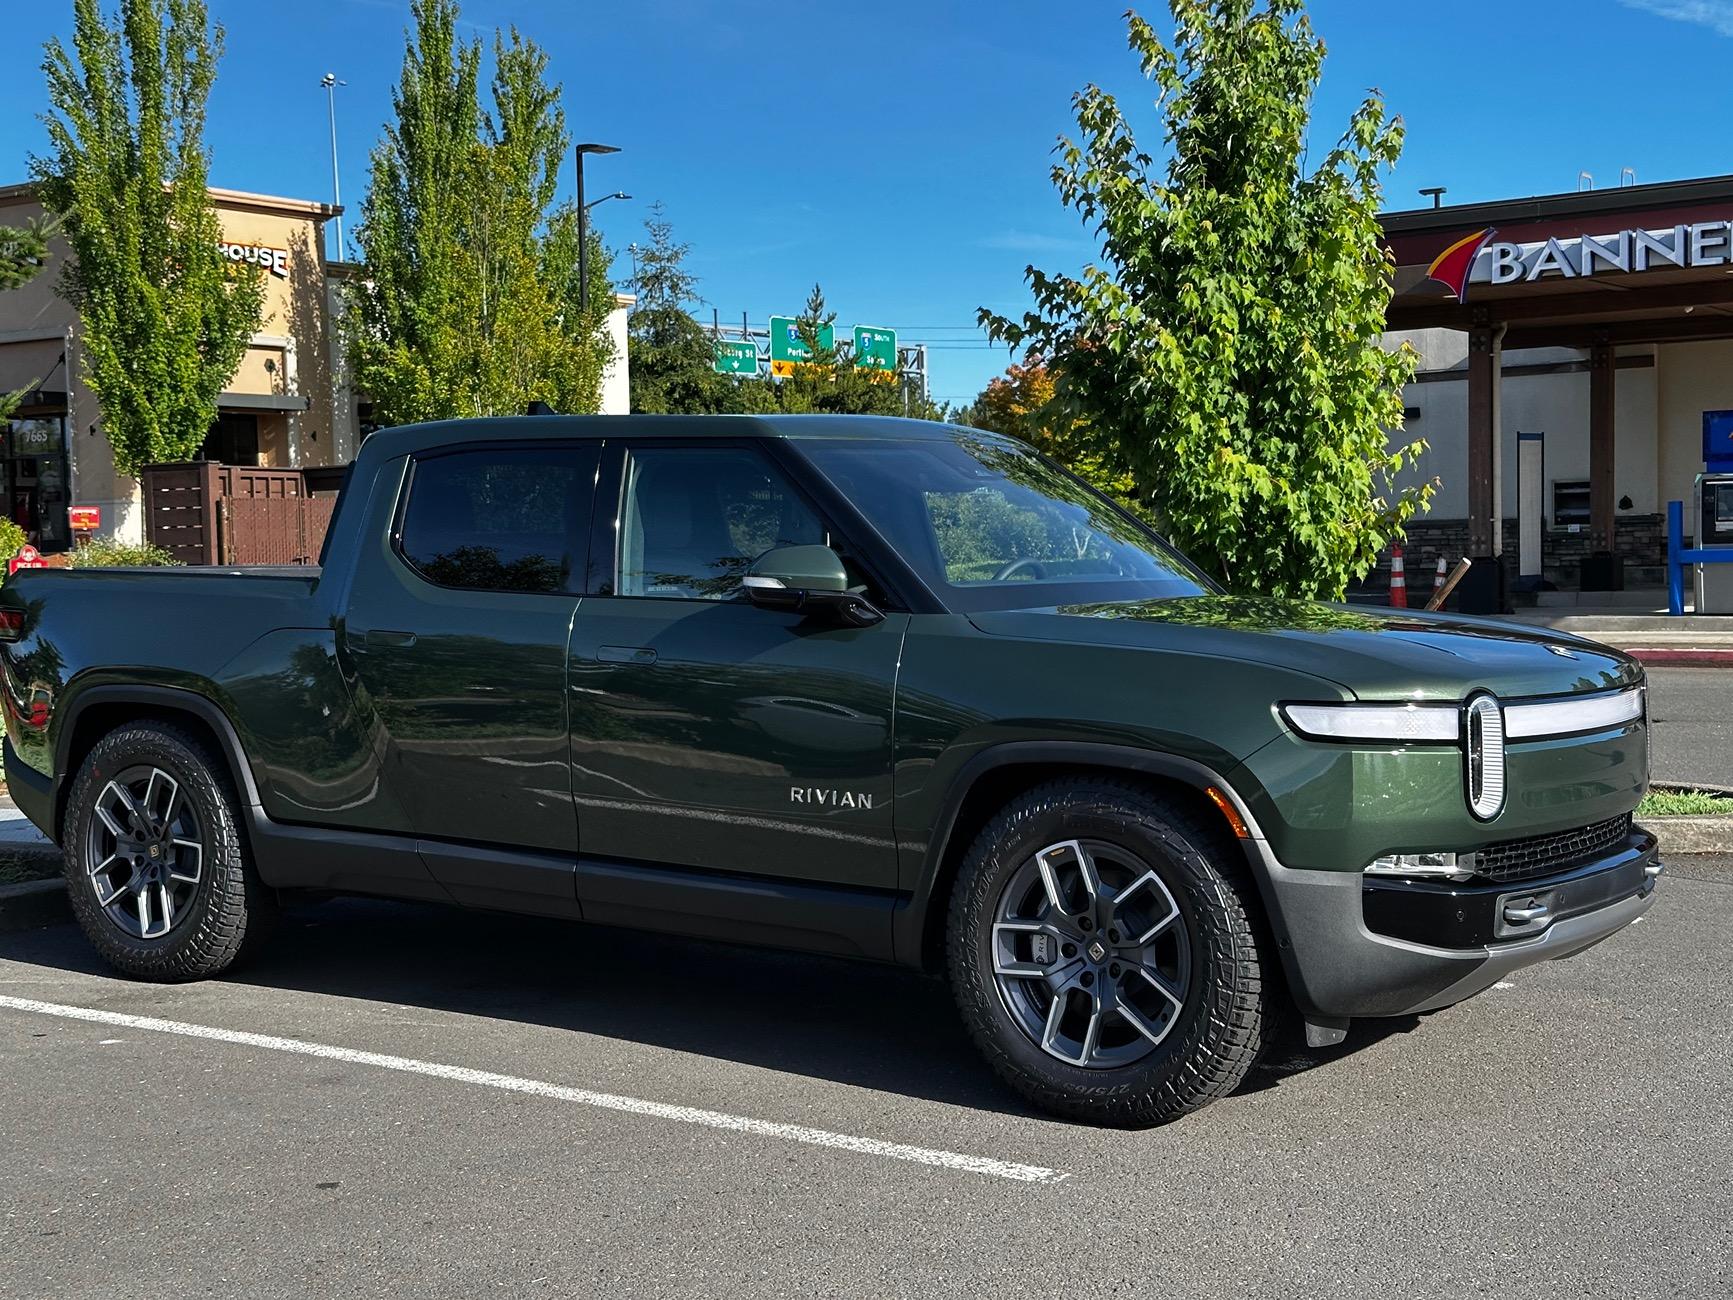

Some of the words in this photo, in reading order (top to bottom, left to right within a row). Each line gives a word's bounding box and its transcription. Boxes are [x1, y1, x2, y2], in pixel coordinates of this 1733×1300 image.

[1490, 220, 1733, 285] BANNE
[864, 337, 869, 347] 5
[744, 349, 754, 358] St
[25, 430, 48, 442] 7665
[790, 786, 873, 809] RIVIAN
